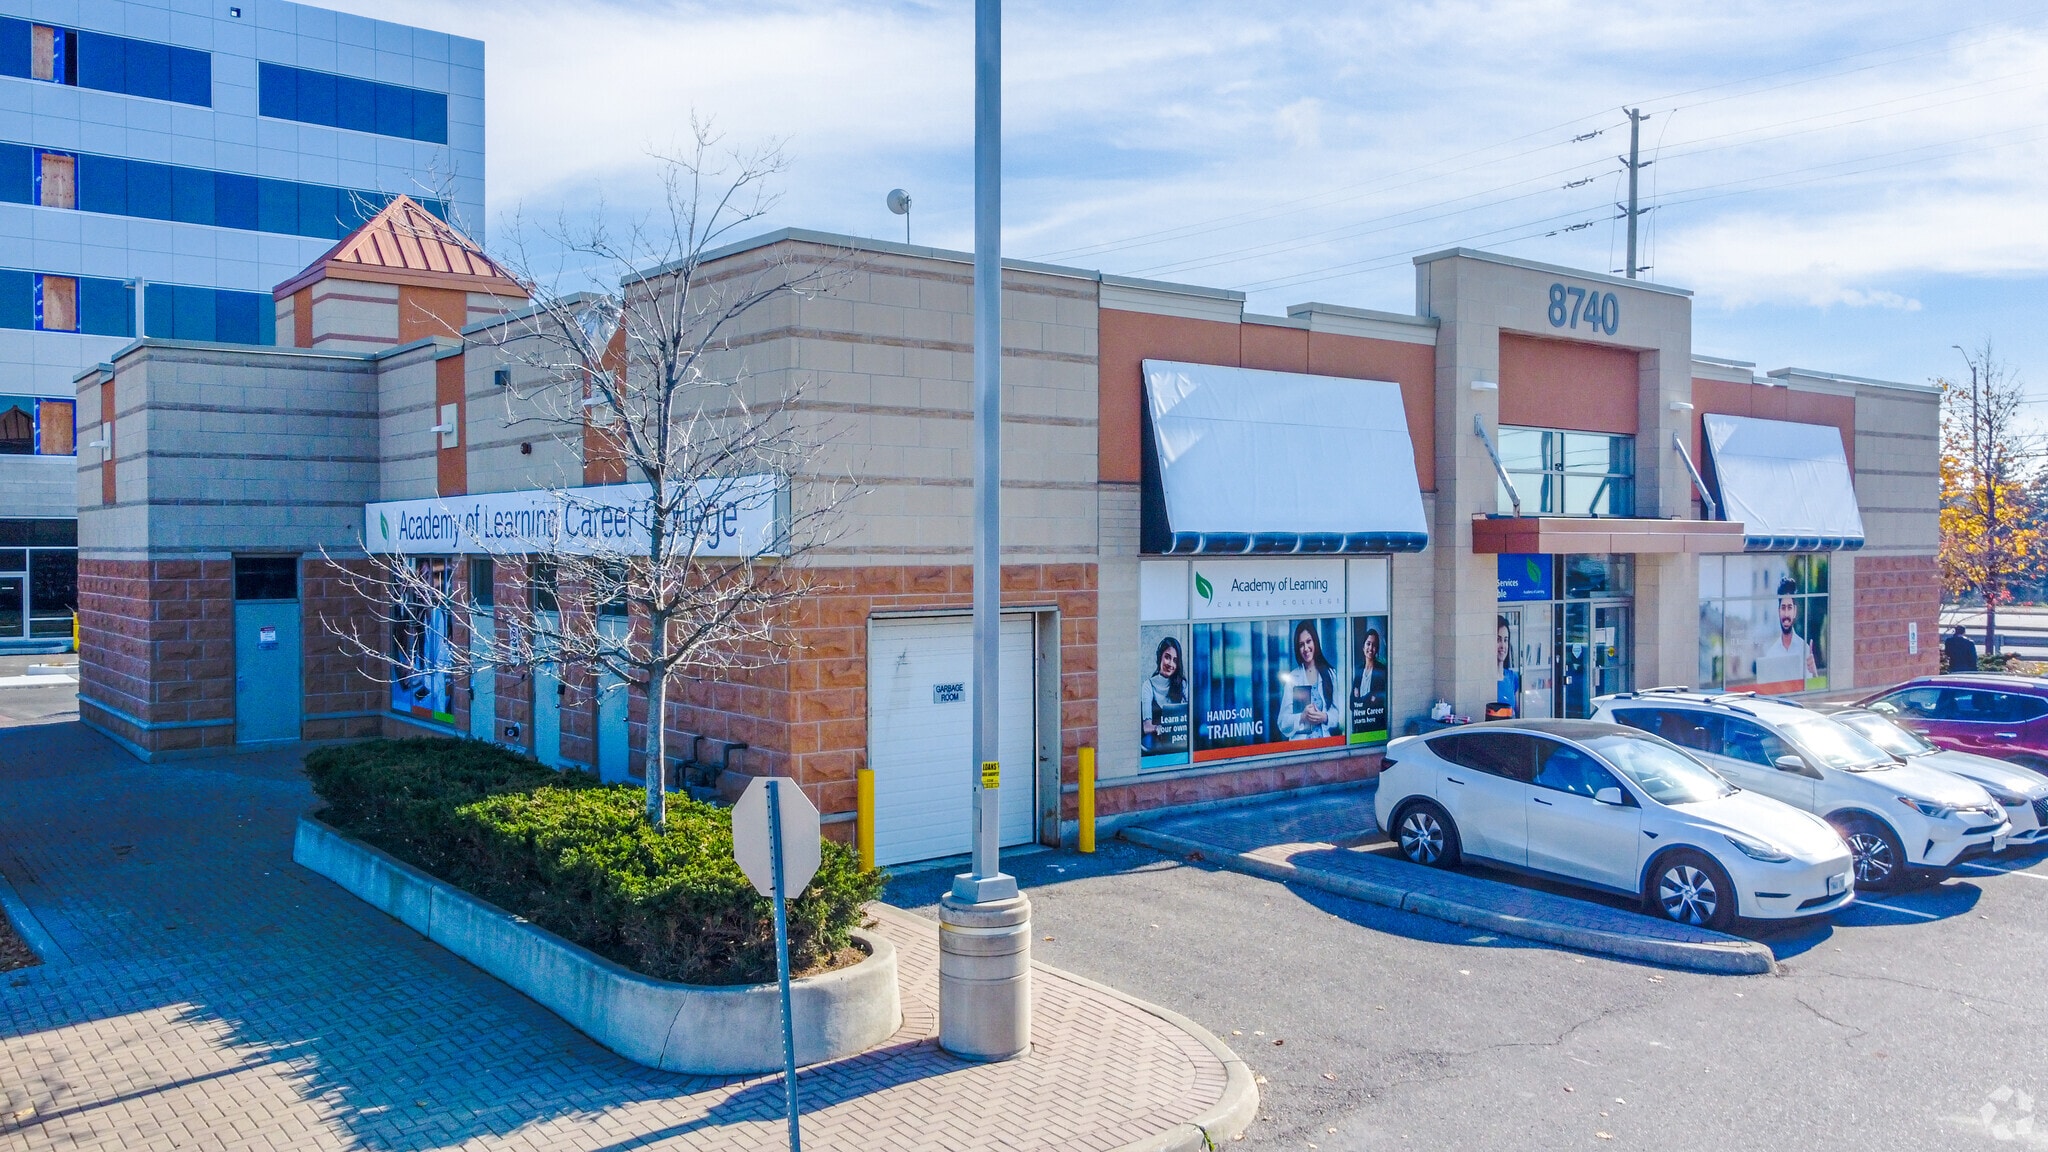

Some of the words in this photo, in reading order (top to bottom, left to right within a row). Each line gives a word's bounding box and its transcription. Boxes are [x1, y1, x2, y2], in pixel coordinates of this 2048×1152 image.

[1548, 283, 1619, 336] 8740
[400, 507, 462, 548] Academy
[465, 503, 480, 537] of
[565, 499, 637, 537] Career
[643, 495, 738, 549] Cllege
[1231, 578, 1276, 594] Academy
[1278, 577, 1288, 591] of
[1289, 577, 1328, 593] Learning
[1217, 600, 1270, 608] CAREER
[1282, 598, 1340, 606] COLLEGE
[935, 684, 963, 693] GARBAGE
[940, 693, 959, 701] ROOM
[1206, 708, 1253, 721] HANDS-ON
[1366, 707, 1384, 715] Career
[1161, 716, 1179, 724] Learn
[1180, 714, 1187, 722] at
[1157, 726, 1172, 735] your
[1207, 721, 1263, 739] TRAINING
[1171, 734, 1187, 743] pace
[982, 763, 997, 771] LOANS
